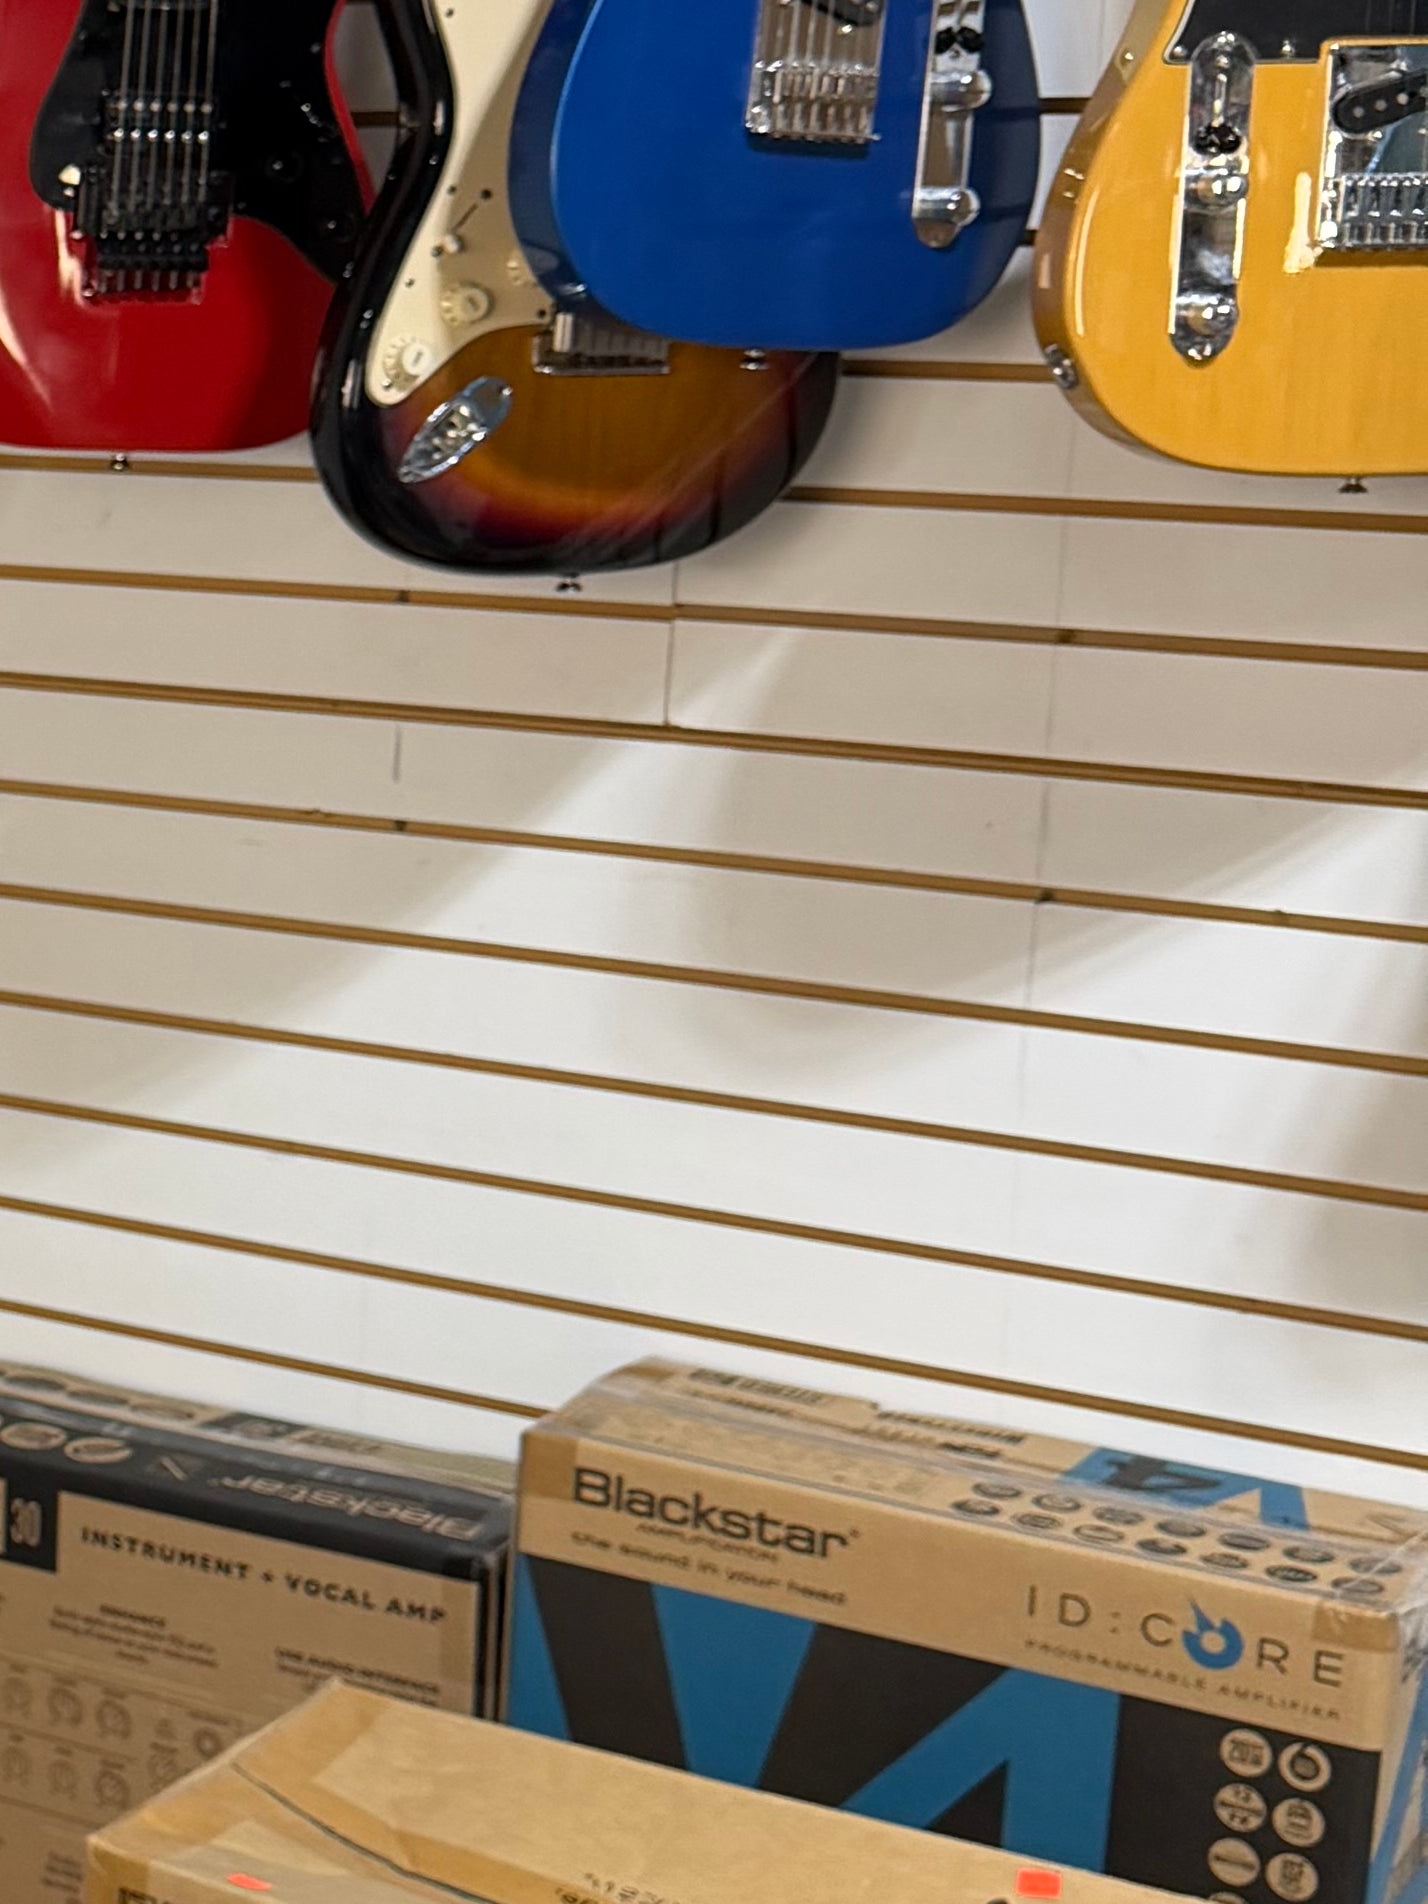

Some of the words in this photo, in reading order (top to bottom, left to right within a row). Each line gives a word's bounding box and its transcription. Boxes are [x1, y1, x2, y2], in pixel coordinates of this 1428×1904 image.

[574, 1467, 850, 1558] Blackstar
[81, 1526, 250, 1580] INSTRUMENT
[285, 1573, 375, 1610] VOCAL
[385, 1596, 447, 1624] AMP
